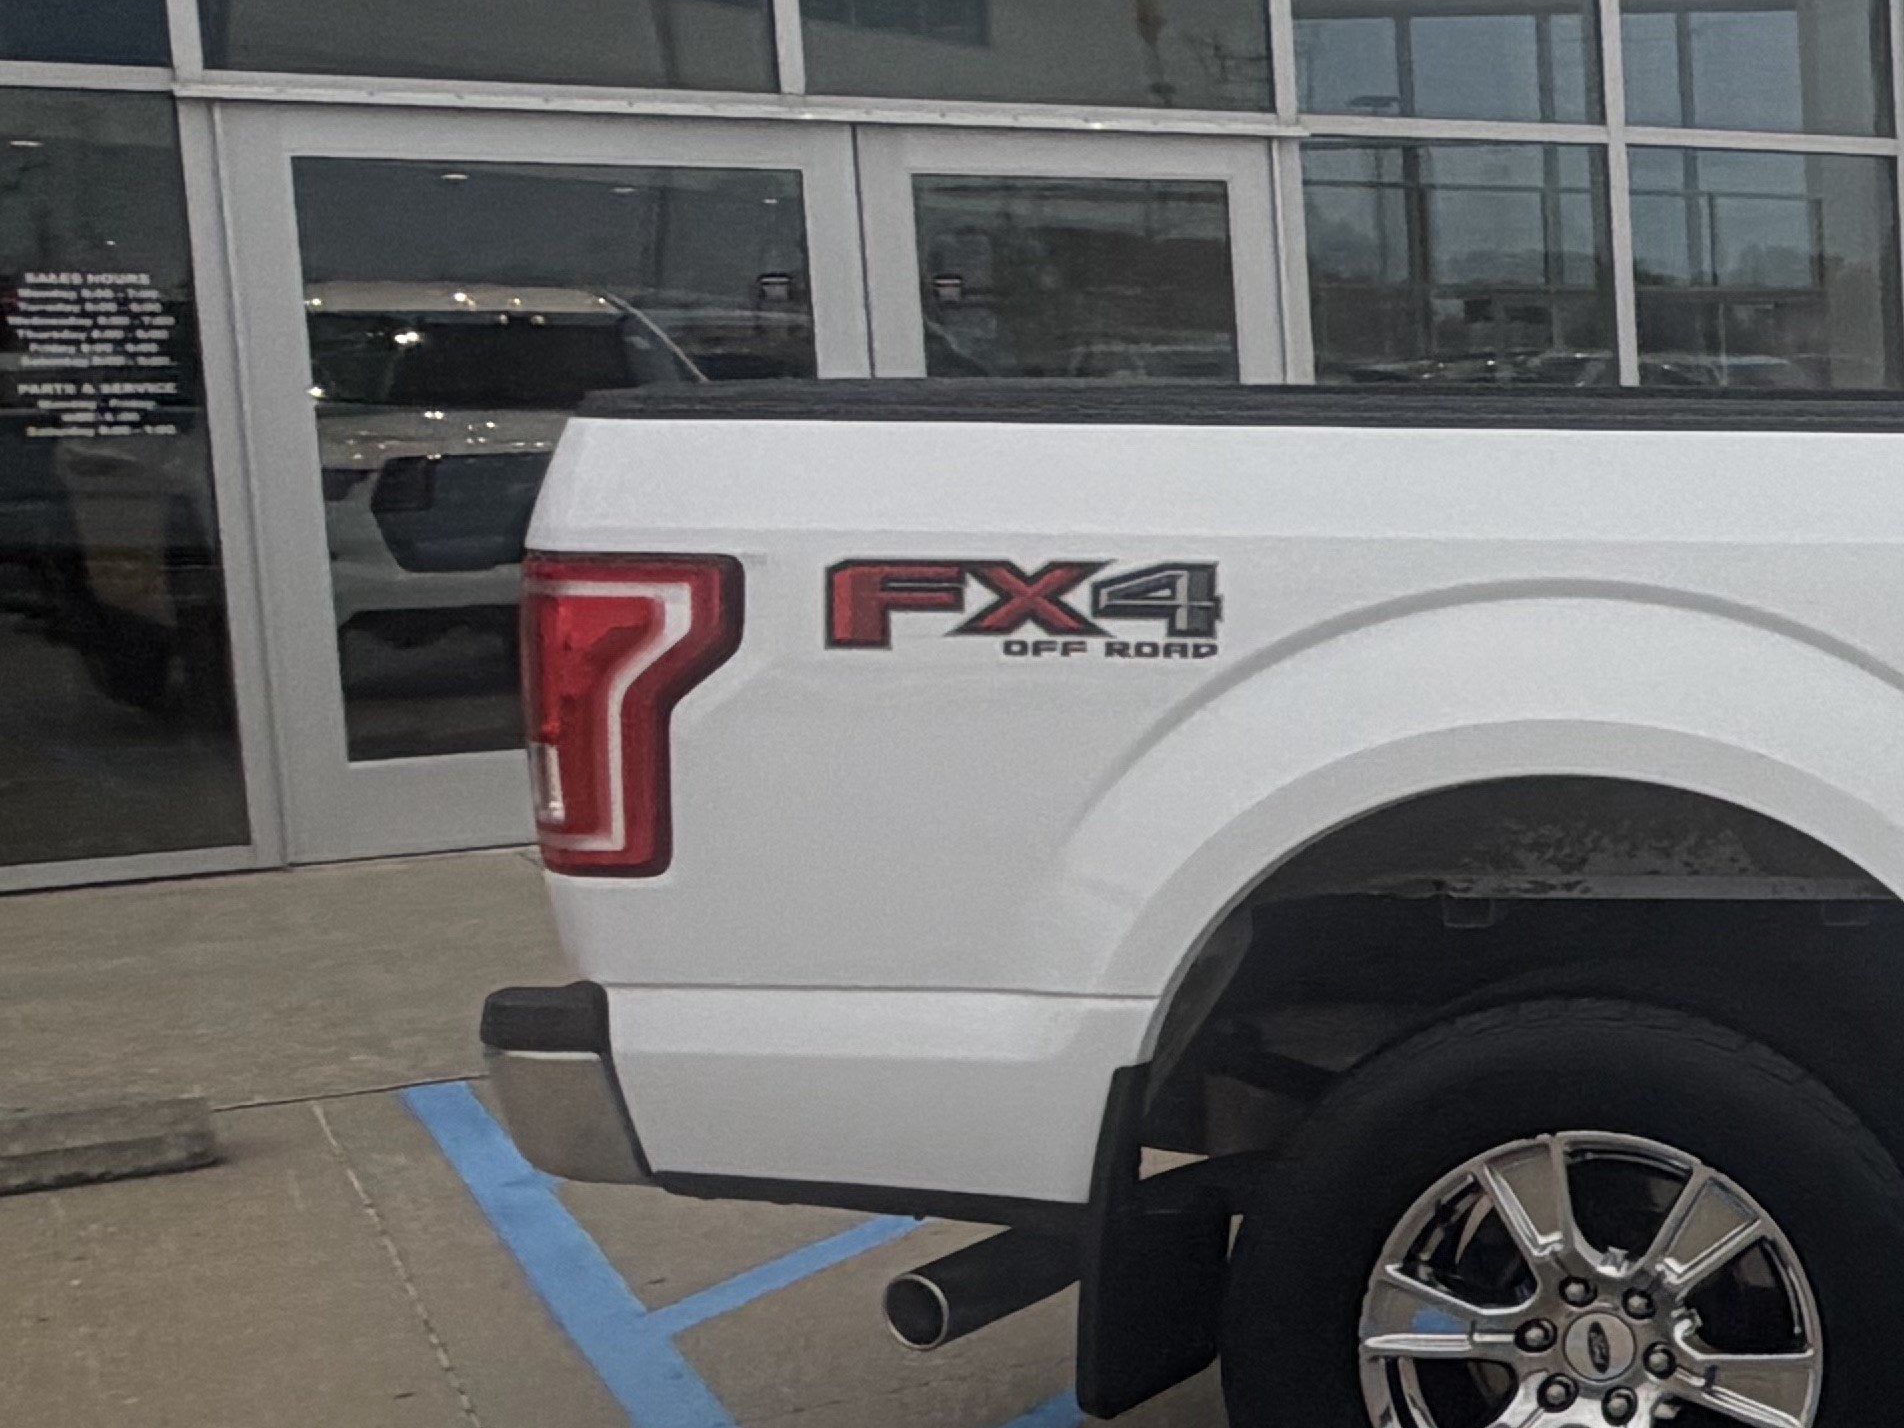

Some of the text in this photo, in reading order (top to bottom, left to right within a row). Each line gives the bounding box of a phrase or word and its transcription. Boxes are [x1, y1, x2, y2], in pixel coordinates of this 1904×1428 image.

[24, 272, 151, 286] SALES HOURS
[99, 383, 178, 394] SERVICE
[824, 557, 1225, 650] FX4
[1002, 639, 1219, 660] OFF ROAD
